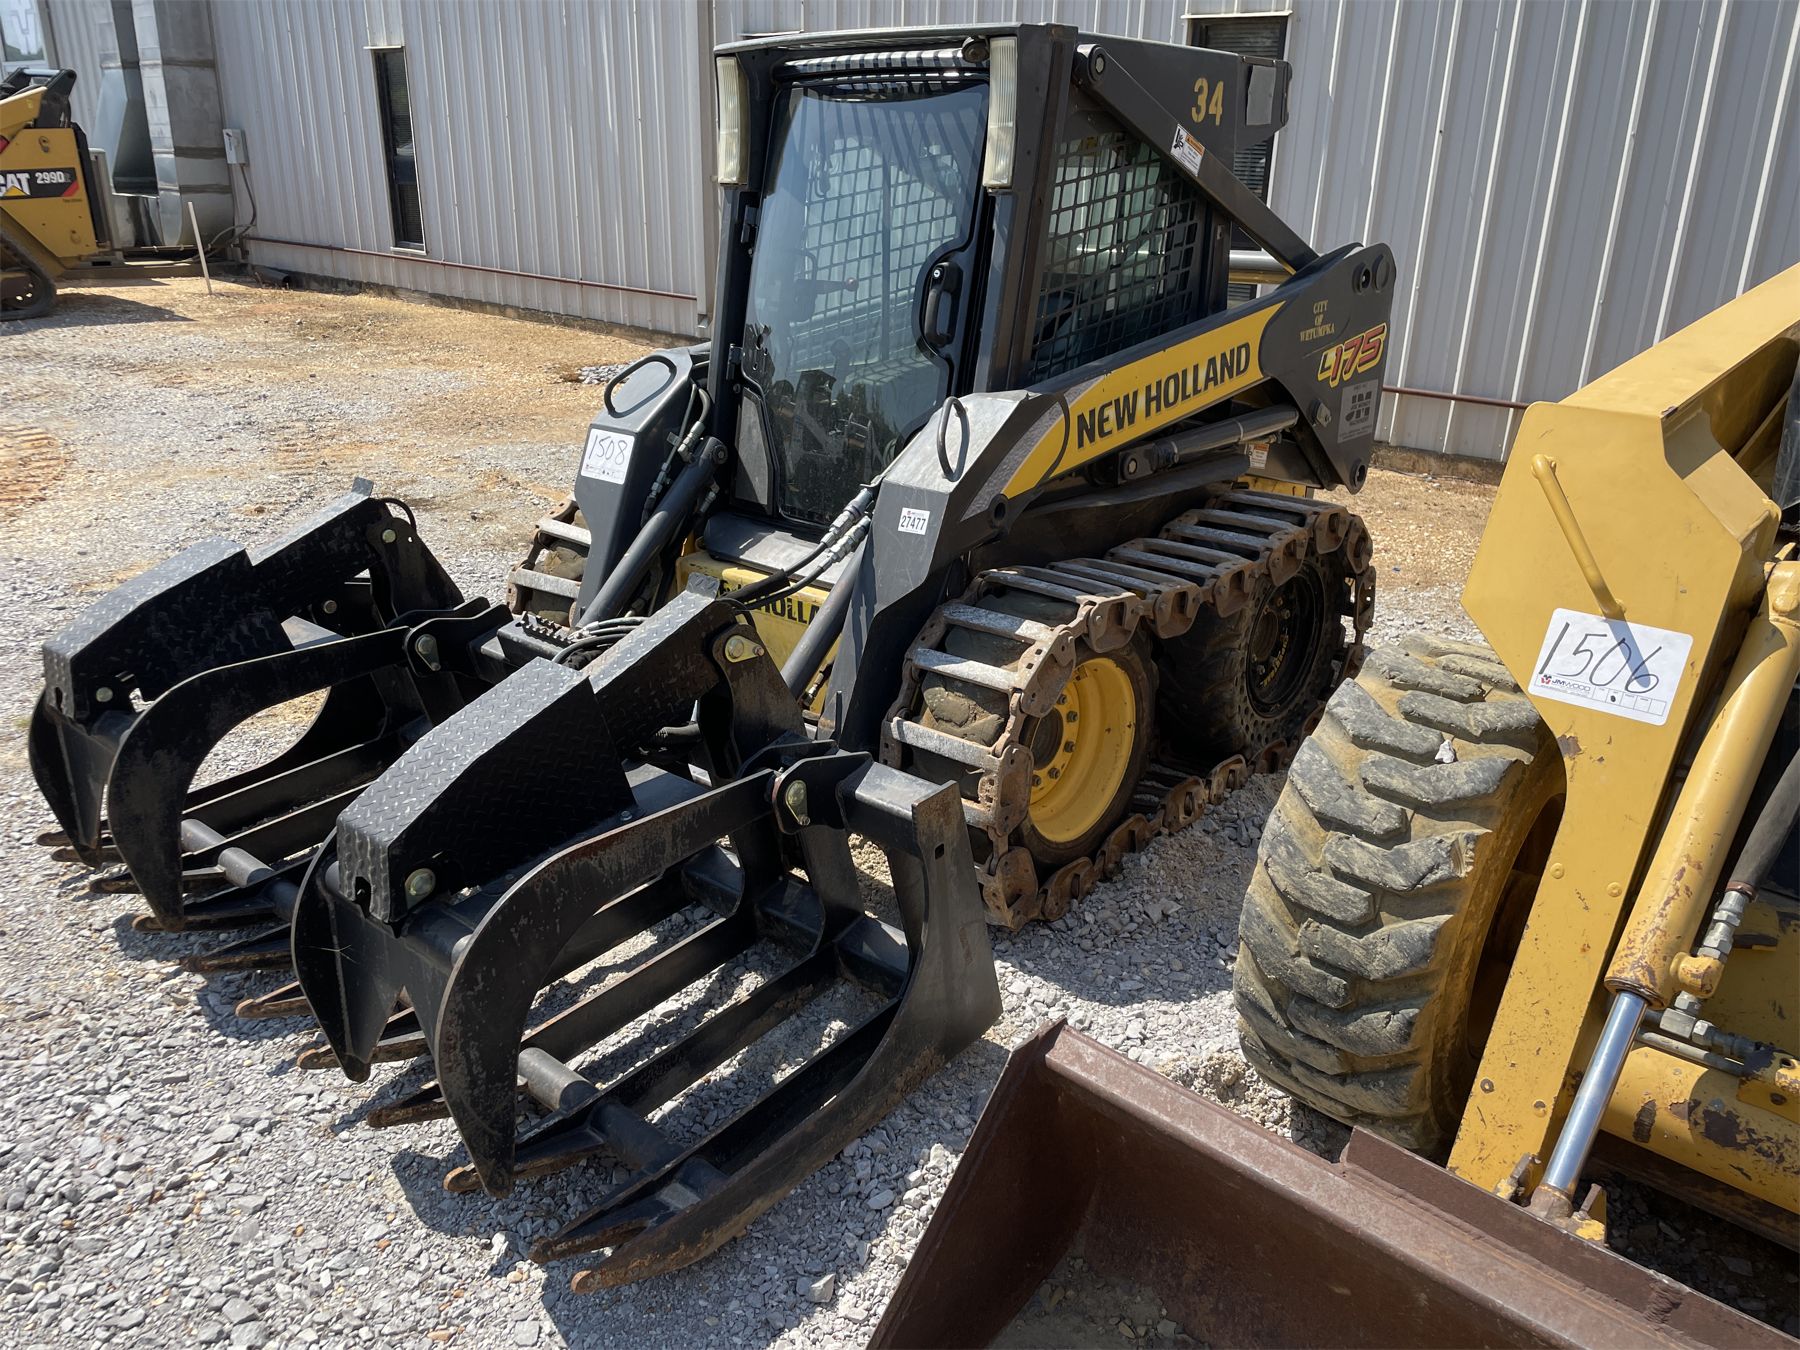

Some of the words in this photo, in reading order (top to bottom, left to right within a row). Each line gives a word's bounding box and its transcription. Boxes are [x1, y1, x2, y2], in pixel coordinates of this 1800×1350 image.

[1191, 77, 1224, 126] 34
[1313, 300, 1329, 314] CITY
[1077, 389, 1139, 449] NEW
[1145, 342, 1250, 418] HOLLAND
[588, 434, 628, 466] 1508
[900, 515, 927, 531] 27477
[1538, 621, 1663, 694] 1506
